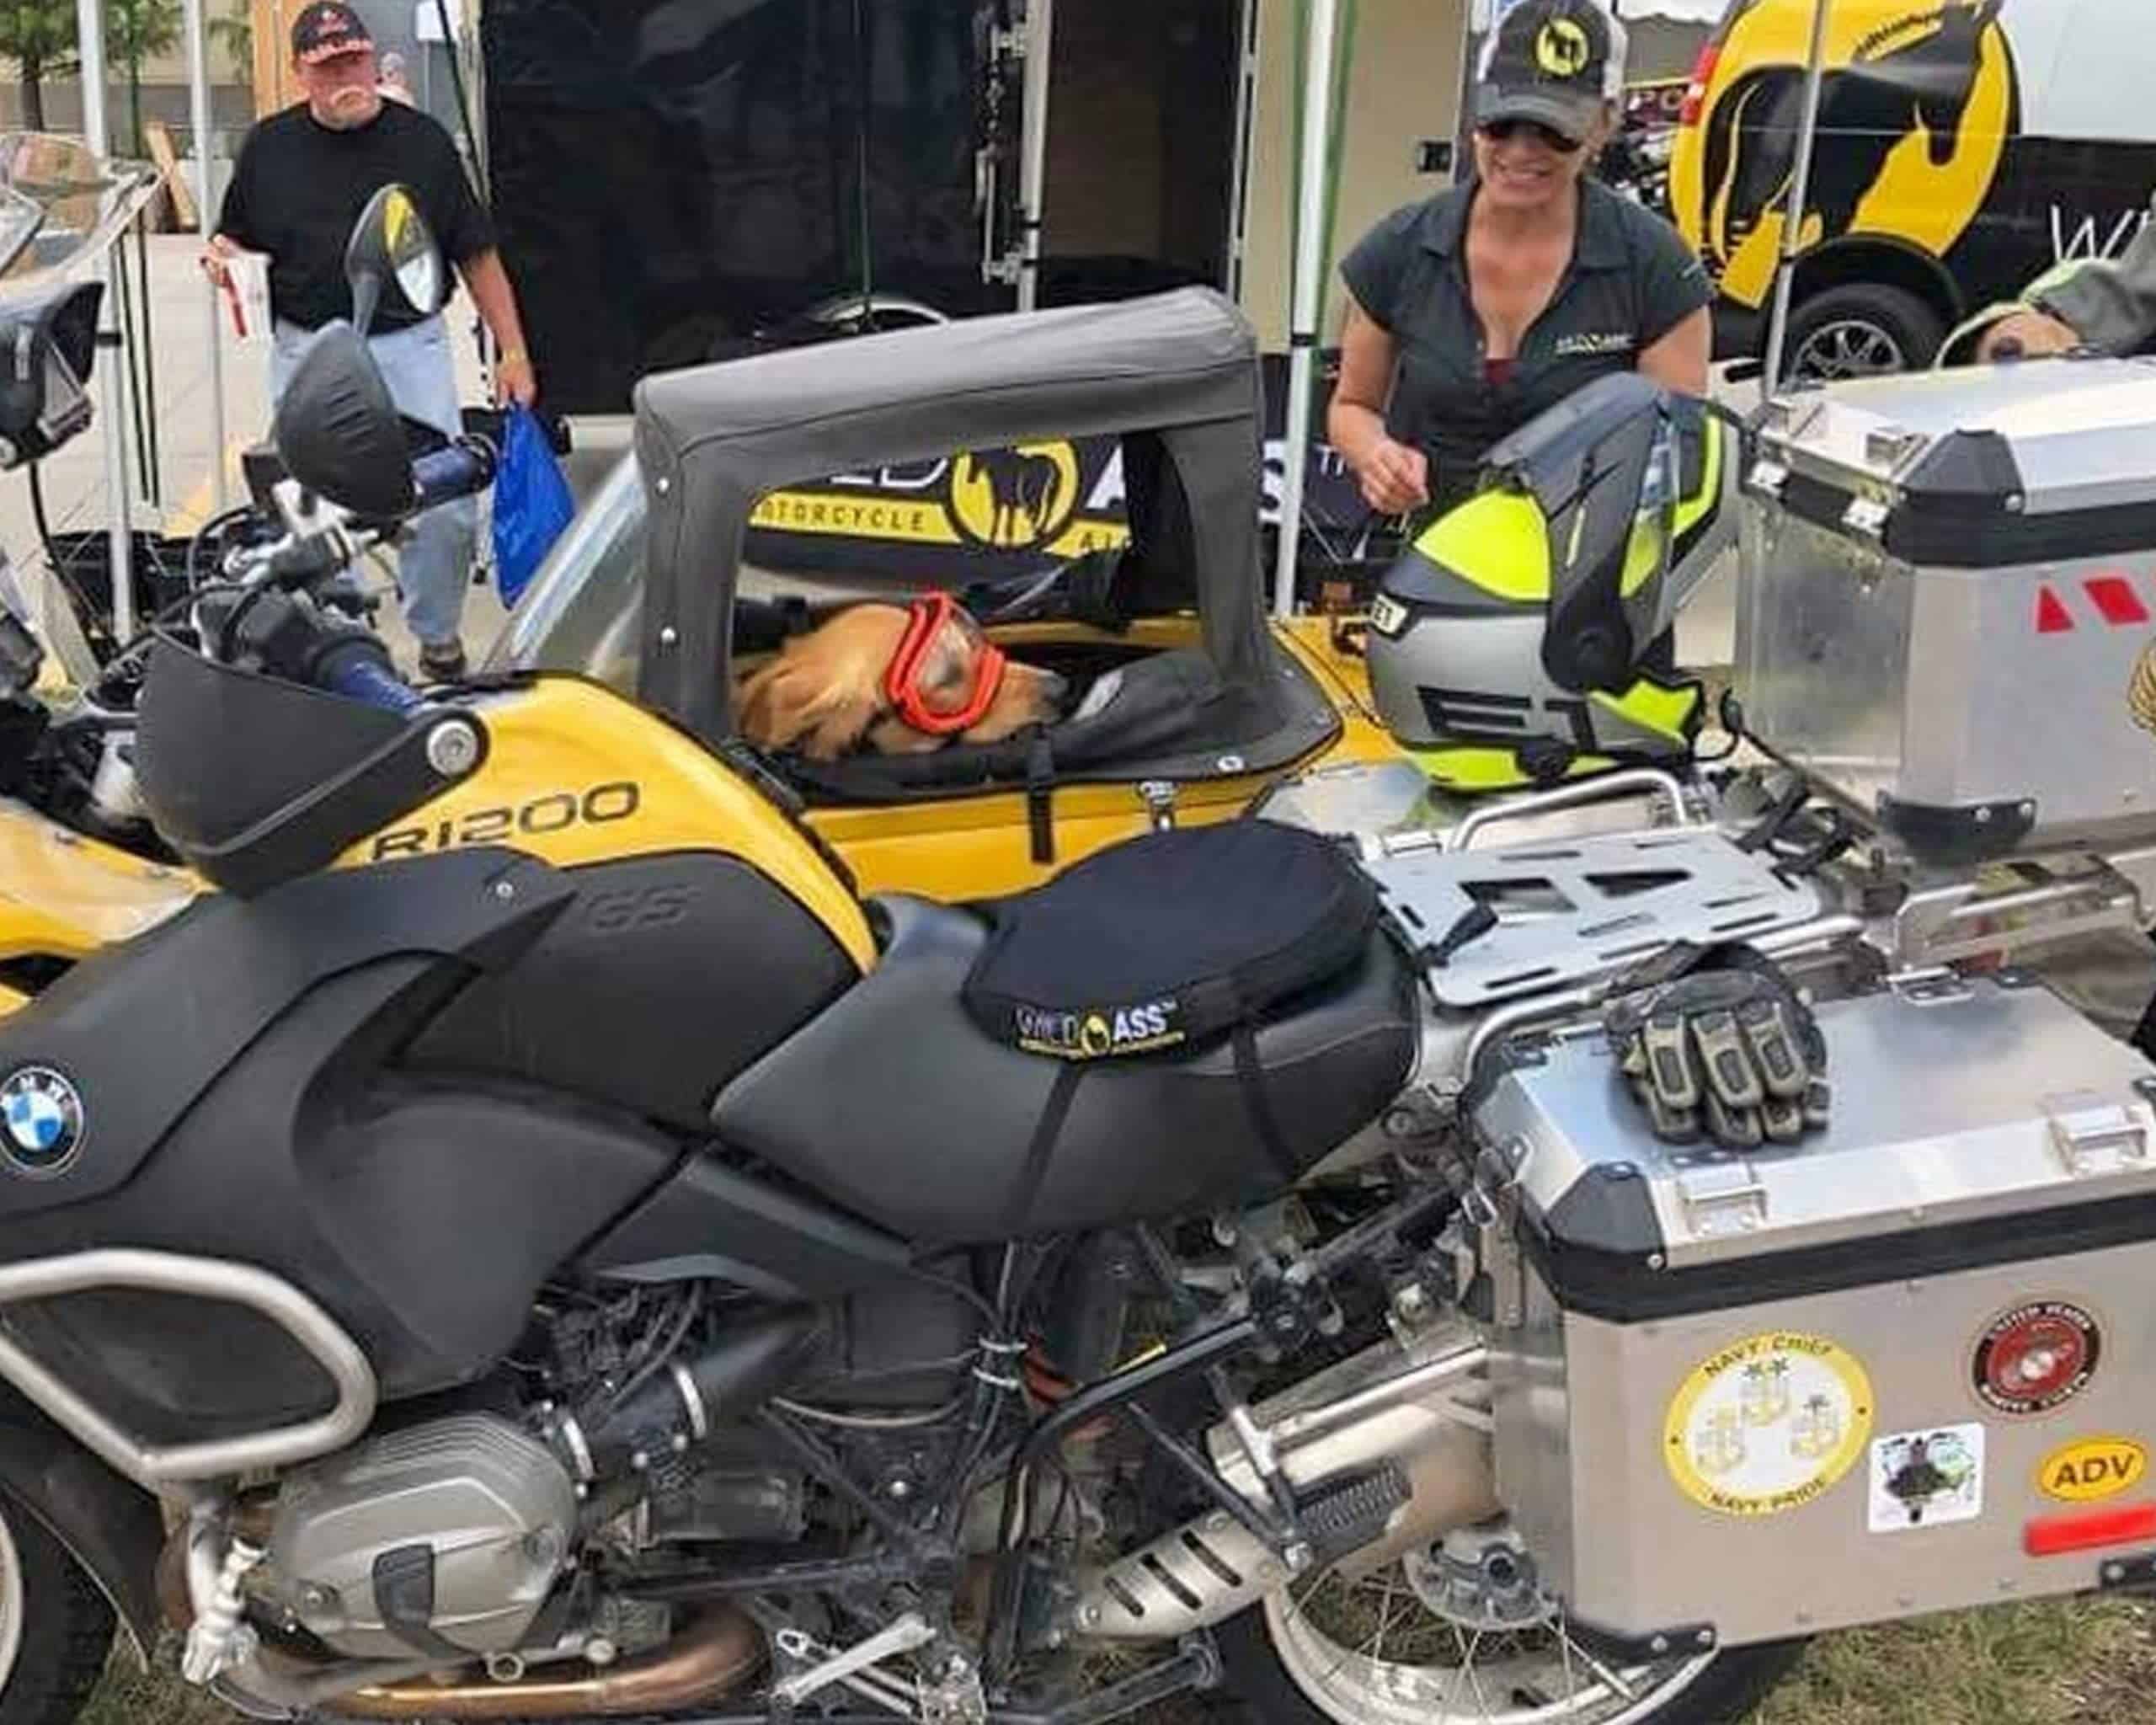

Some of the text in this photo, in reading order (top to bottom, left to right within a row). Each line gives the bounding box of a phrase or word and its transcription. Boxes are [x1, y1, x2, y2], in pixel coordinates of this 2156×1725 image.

[2050, 204, 2150, 260] W
[1114, 1003, 1166, 1042] ASS
[1703, 1340, 1758, 1378] NAVY
[2052, 1452, 2135, 1488] ADV
